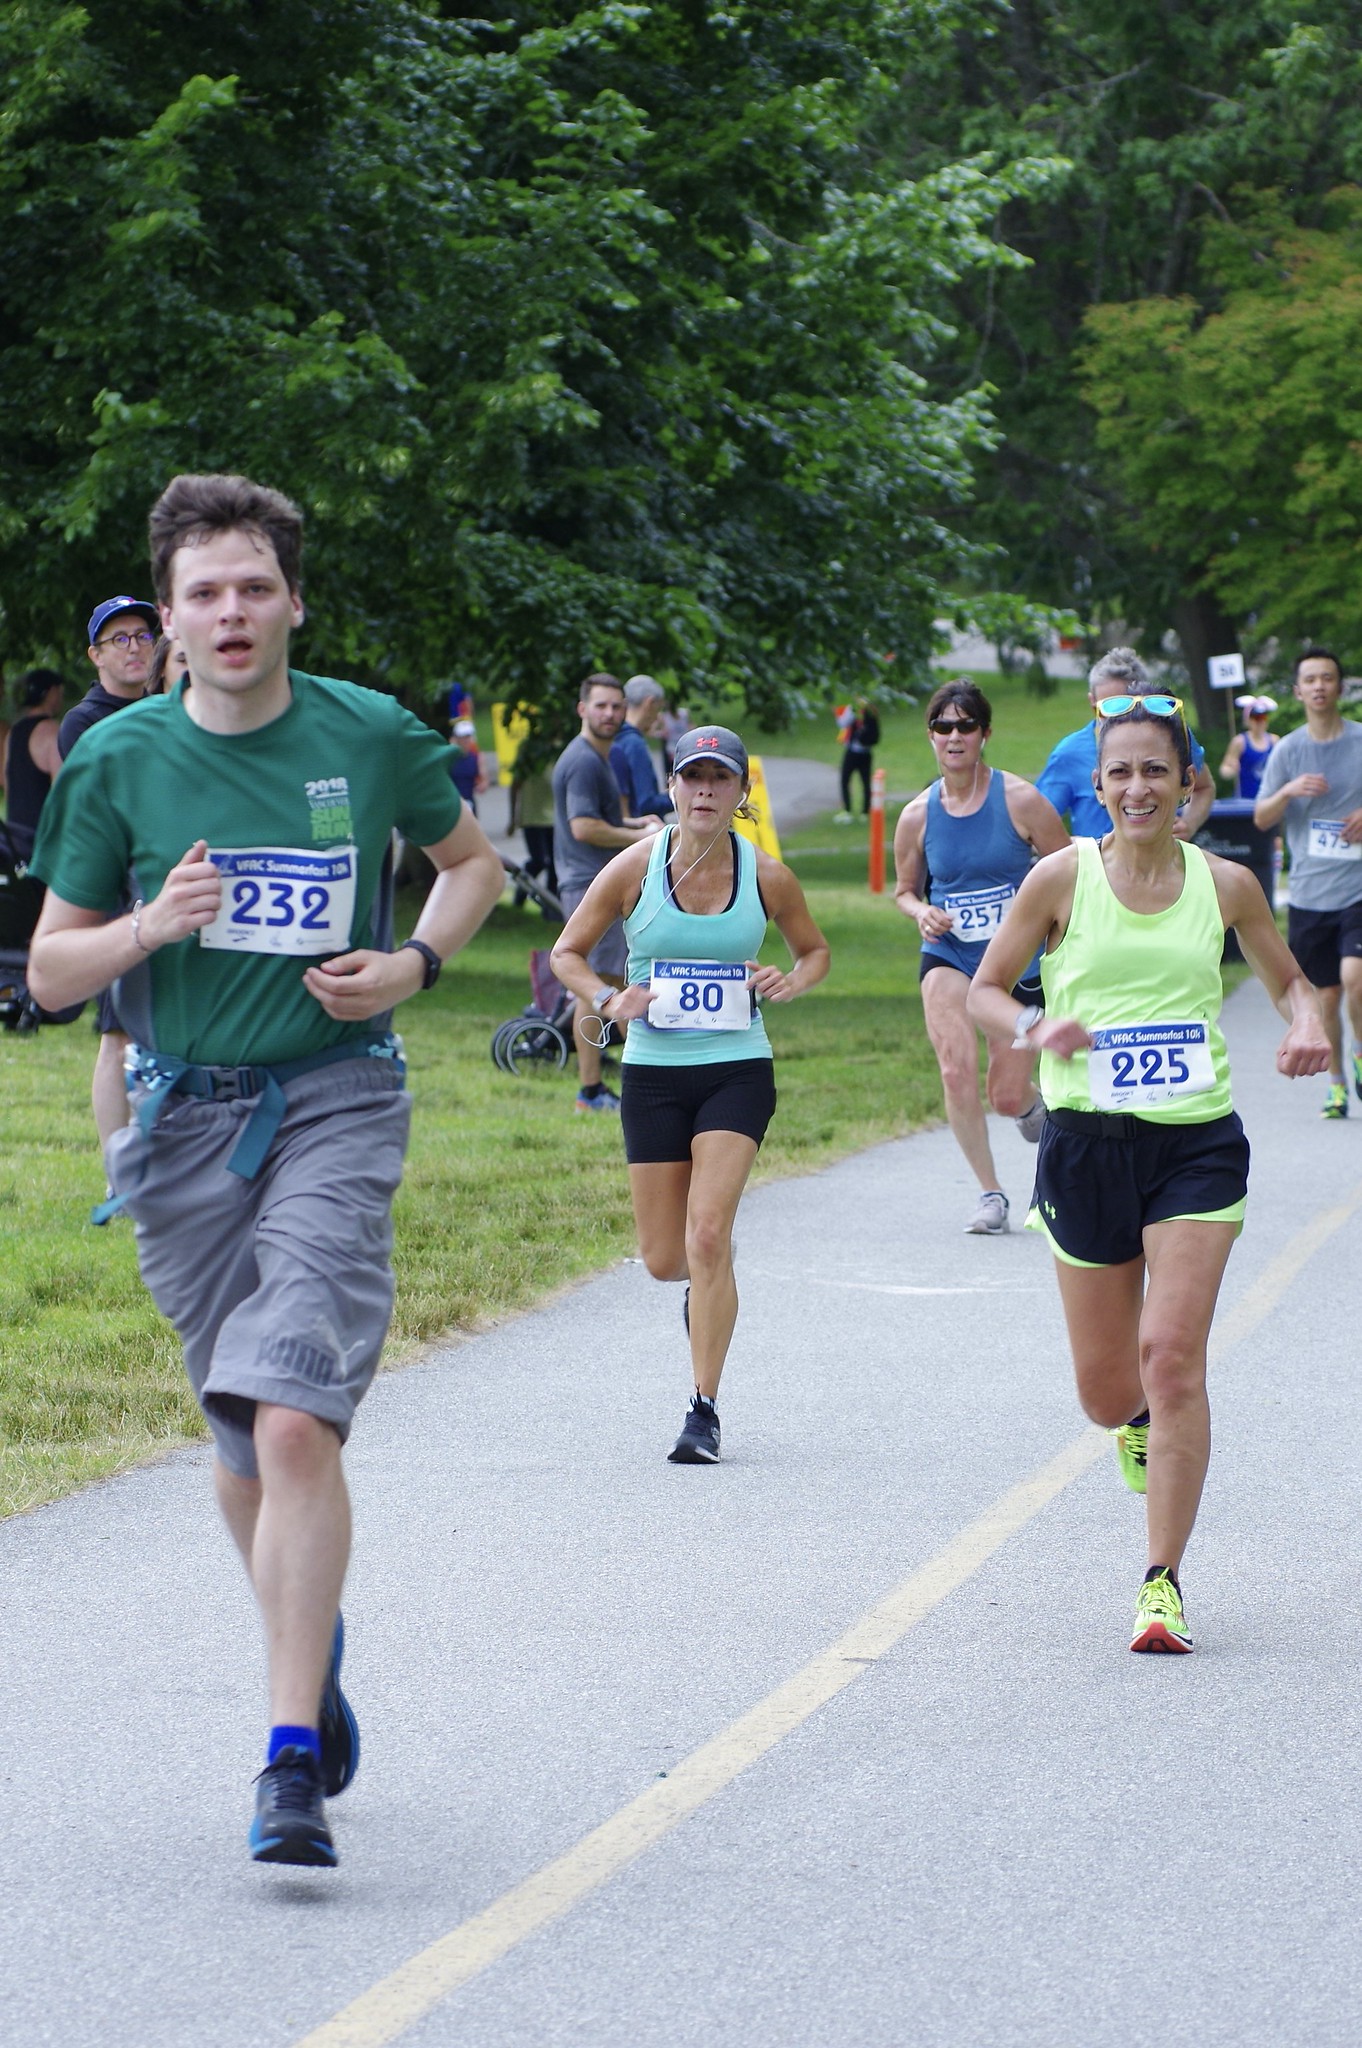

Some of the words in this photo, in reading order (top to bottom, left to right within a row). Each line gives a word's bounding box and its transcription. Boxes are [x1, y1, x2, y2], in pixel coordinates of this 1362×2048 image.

[304, 776, 348, 796] 2018
[310, 806, 350, 822] SUN
[311, 819, 353, 840] RUN
[236, 860, 265, 872] VFAC
[266, 861, 329, 876] Summerfast
[231, 880, 330, 929] 232
[960, 903, 1002, 930] 257
[671, 966, 690, 976] VFAC
[690, 967, 731, 977] Summerfast
[732, 968, 744, 978] 10k
[679, 982, 724, 1013] 80
[1111, 1032, 1135, 1044] VFAC
[1135, 1029, 1184, 1042] Summerfast
[1185, 1028, 1201, 1040] 10k
[1111, 1047, 1190, 1088] 225
